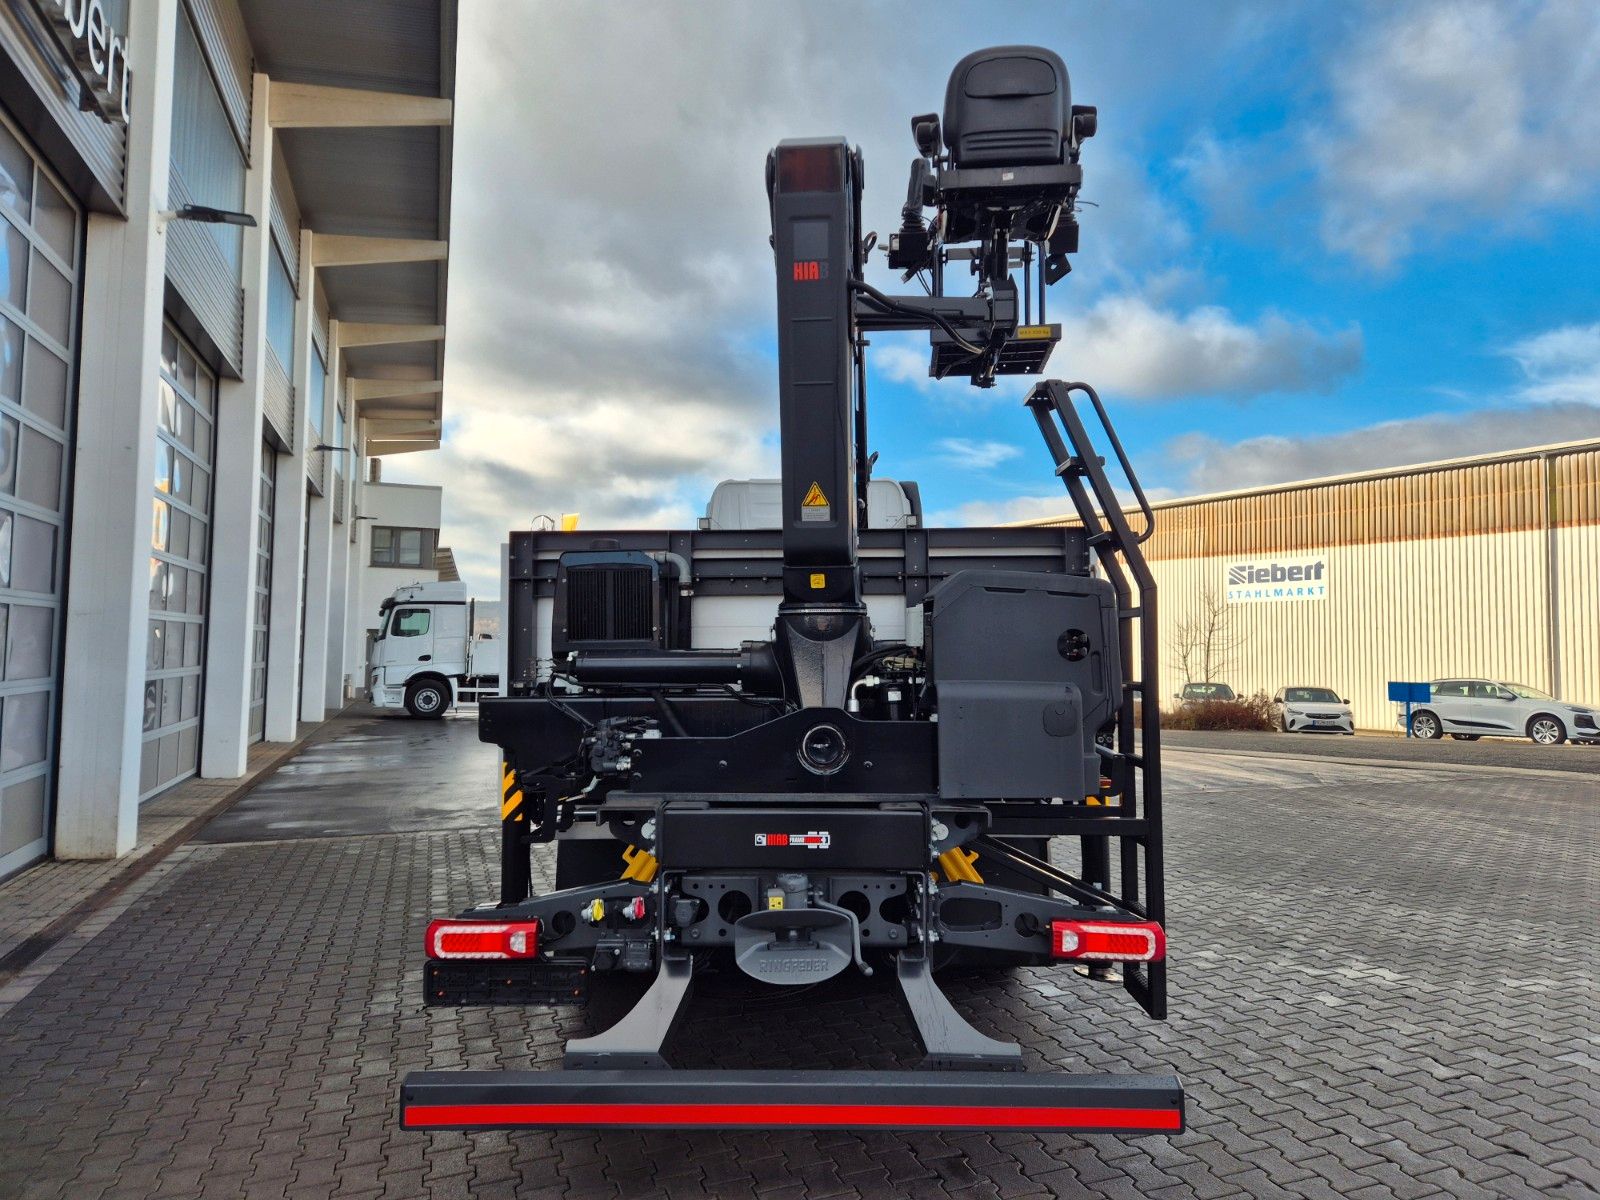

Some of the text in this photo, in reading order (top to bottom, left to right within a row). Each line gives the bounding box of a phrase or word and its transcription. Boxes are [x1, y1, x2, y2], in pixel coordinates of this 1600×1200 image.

[1228, 560, 1325, 585] Siebert
[1228, 586, 1325, 599] STAHLMARKT
[766, 833, 788, 846] HIAB
